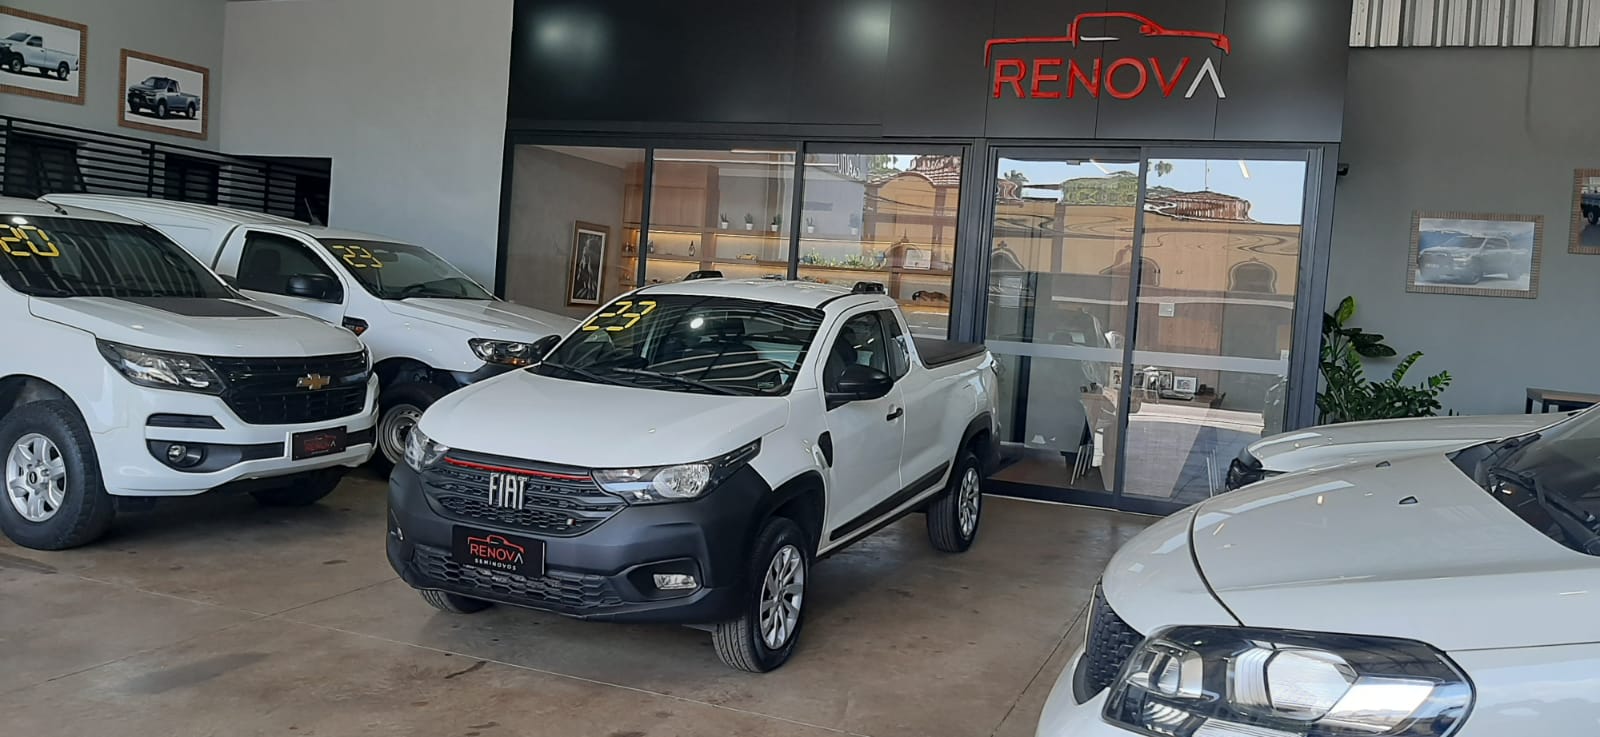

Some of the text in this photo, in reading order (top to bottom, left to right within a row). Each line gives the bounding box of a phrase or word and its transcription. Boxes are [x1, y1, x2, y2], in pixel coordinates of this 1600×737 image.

[993, 56, 1227, 100] RENOVA
[331, 245, 384, 268] 23
[582, 301, 657, 331] 23
[488, 472, 529, 510] FIAT
[470, 543, 524, 565] RENOVA
[474, 558, 517, 571] SEMINOVOS
